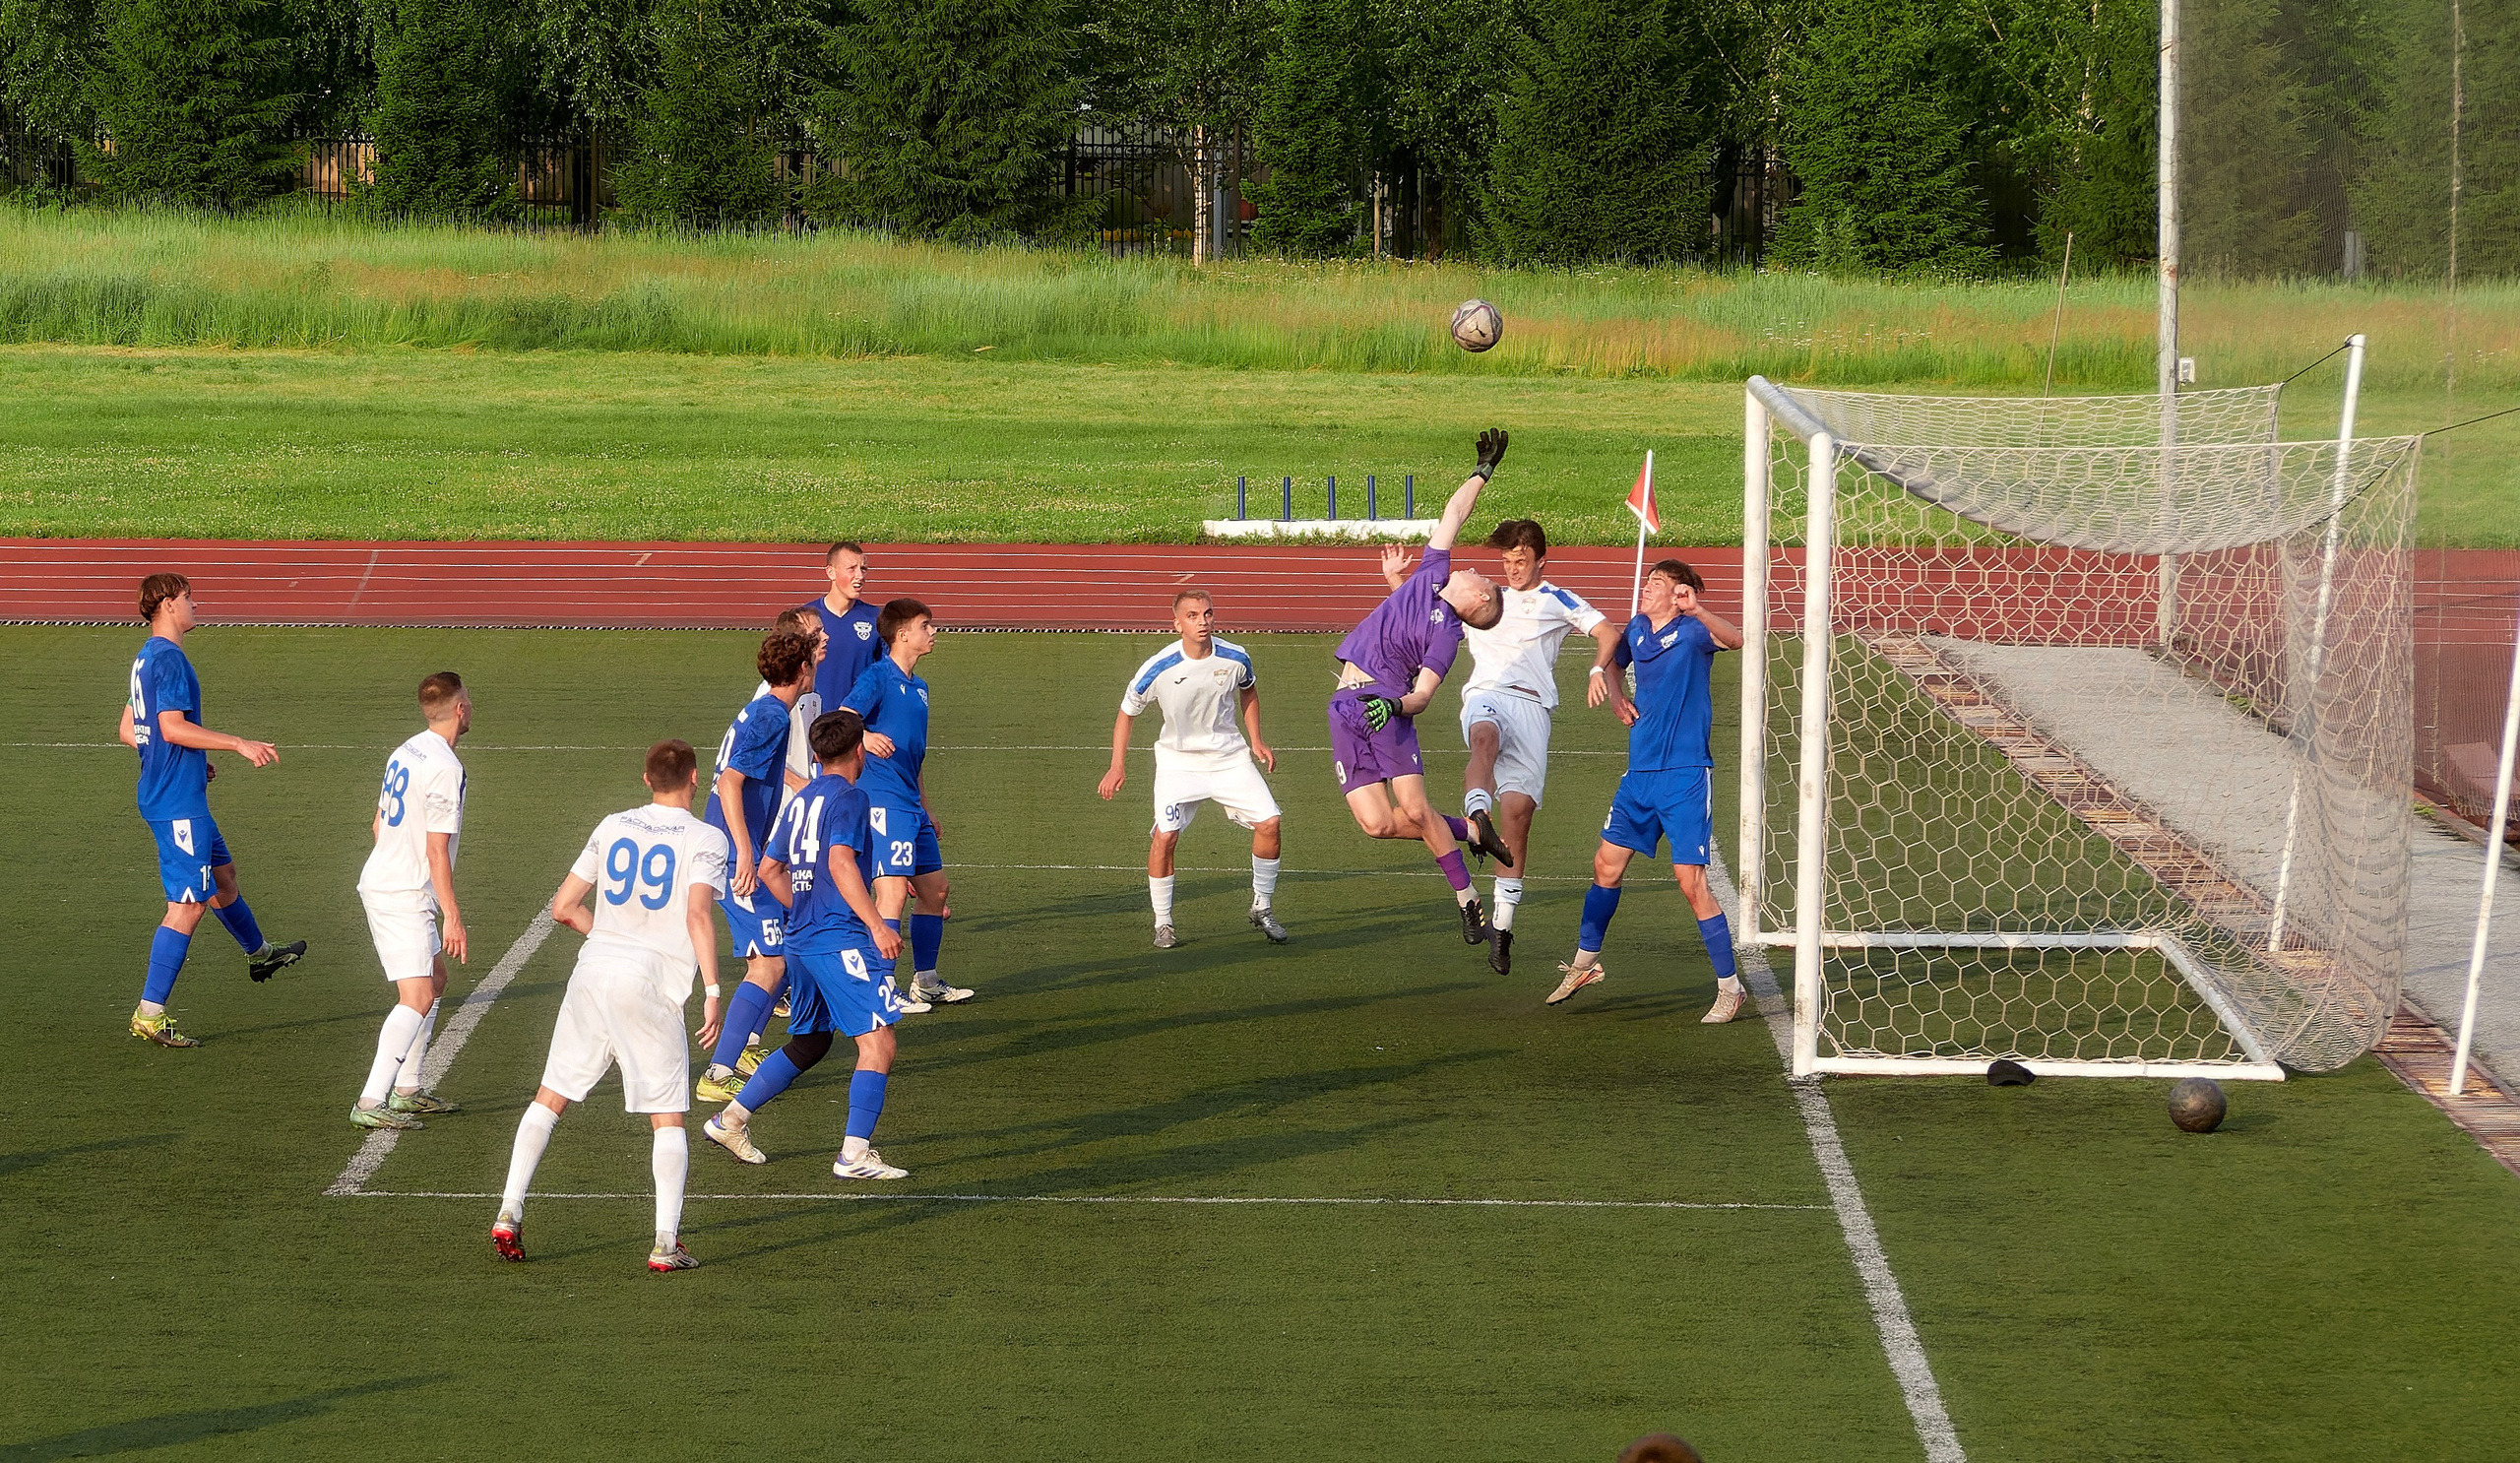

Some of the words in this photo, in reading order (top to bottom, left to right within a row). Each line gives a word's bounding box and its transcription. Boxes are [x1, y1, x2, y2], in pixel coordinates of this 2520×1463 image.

[788, 795, 825, 864] 24
[604, 837, 675, 911] 99
[891, 841, 913, 866] 23
[762, 920, 784, 945] 55
